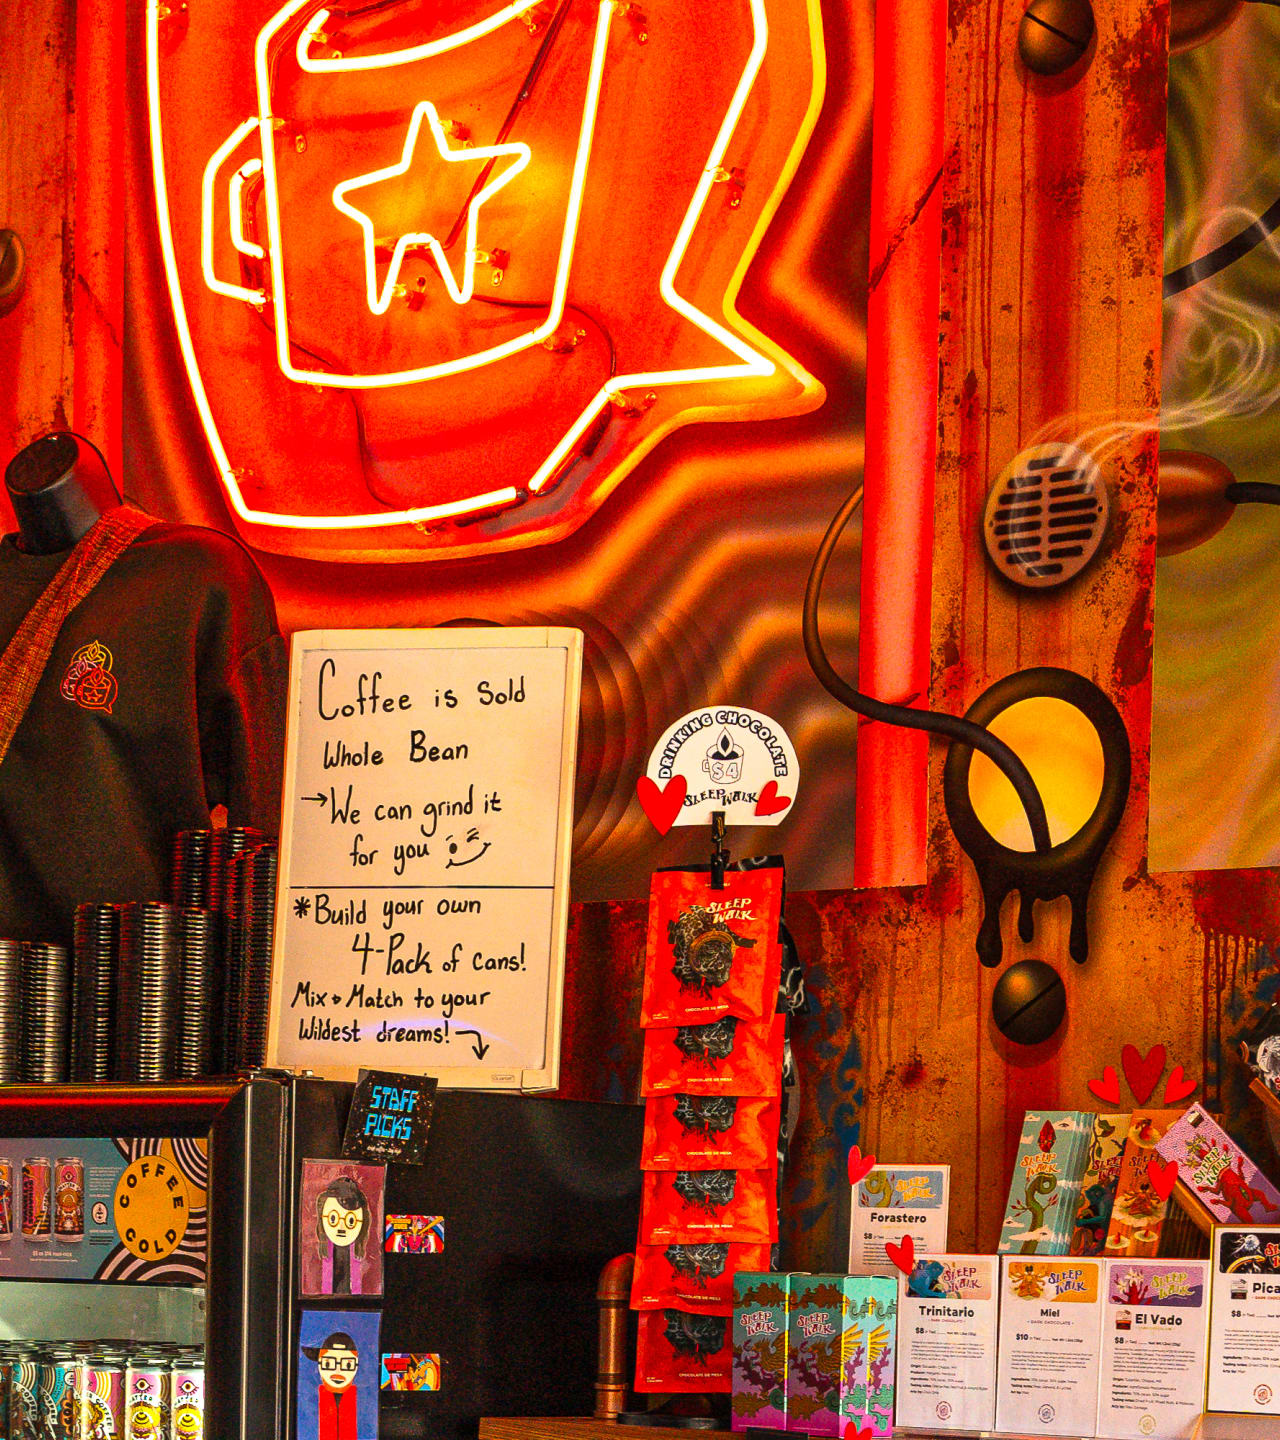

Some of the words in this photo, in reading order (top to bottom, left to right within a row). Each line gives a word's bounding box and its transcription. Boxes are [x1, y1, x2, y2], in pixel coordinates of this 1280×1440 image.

[318, 658, 412, 720] Coffee
[435, 689, 458, 708] is
[477, 675, 525, 705] Sold
[324, 740, 384, 769] Whole
[409, 730, 468, 762] Bean
[658, 713, 713, 779] DRINKING
[715, 710, 788, 777] CHOCOLATE
[712, 762, 739, 781] $4
[330, 785, 360, 824] We
[375, 803, 412, 821] can
[420, 784, 473, 837] grind
[484, 792, 502, 814] it
[350, 834, 378, 866] for
[394, 842, 429, 875] you
[383, 899, 424, 929] your
[437, 899, 481, 915] own
[706, 898, 752, 914] SLEEP
[713, 909, 758, 924] WALK
[352, 932, 432, 975] 4-Pack
[442, 943, 463, 972] of
[291, 982, 327, 1008] Mix
[345, 984, 403, 1008] Match
[414, 988, 434, 1008] to
[441, 992, 491, 1018] your
[298, 1016, 361, 1042] Wildest
[376, 1020, 450, 1043] dreams!
[370, 1085, 420, 1113] STAFF
[363, 1113, 413, 1140] PICKS
[120, 1162, 184, 1210] COFFEE
[870, 1212, 927, 1224] Forastero
[126, 1228, 177, 1254] COLD
[918, 1305, 975, 1318] Trinitario
[1040, 1308, 1060, 1318] Miel
[1135, 1314, 1147, 1324] El
[1150, 1315, 1183, 1326] Vado
[1231, 1310, 1242, 1318] $8
[1015, 1333, 1029, 1341] $10
